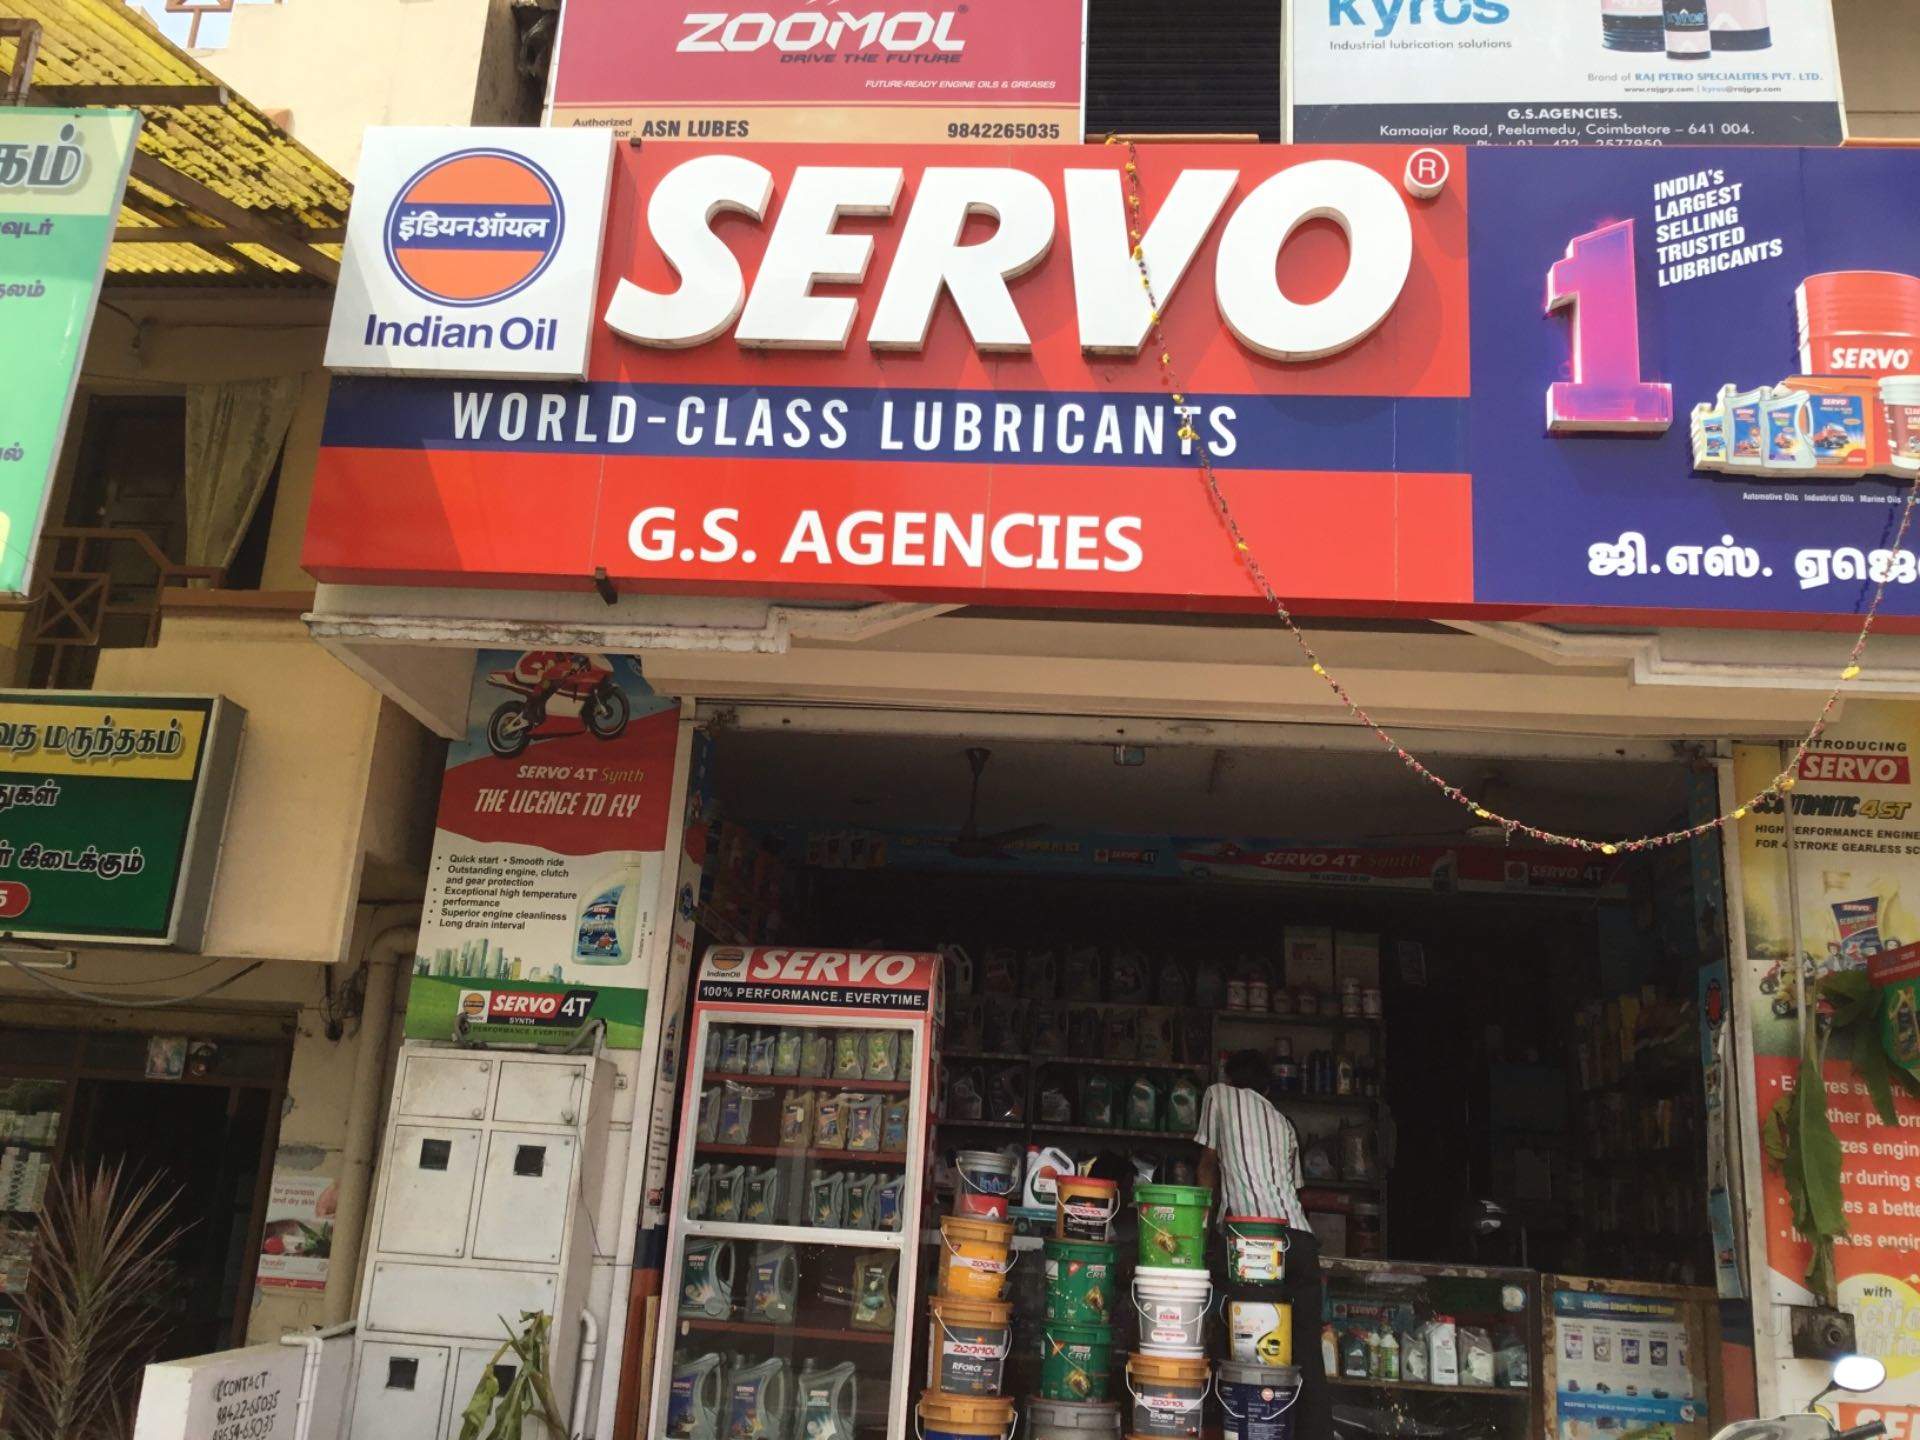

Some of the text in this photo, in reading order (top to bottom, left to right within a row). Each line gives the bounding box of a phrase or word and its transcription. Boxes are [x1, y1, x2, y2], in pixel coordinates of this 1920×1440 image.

[675, 11, 966, 52] ZOOMOL
[1329, 39, 1512, 50] Industrial lubrication solutions
[780, 53, 963, 64] DRIVE THE FUTURE
[865, 80, 937, 89] FUTURE-READY
[939, 80, 976, 89] ENGINE
[978, 81, 1000, 89] OILS
[1010, 81, 1056, 89] GREASES
[1587, 73, 1823, 82] Brand of RAJ PETRO SPECIALITIES PVT. LTD.
[1508, 108, 1622, 120] G.S.AGENCIES.
[572, 118, 633, 128] Authorized
[641, 120, 681, 137] ASN
[688, 120, 750, 138] LUBES
[947, 122, 1060, 140] 9842265035
[1380, 123, 1755, 139] Kamaajar Road, Peelamedu, Coimbatore 641 004.
[1654, 169, 1725, 201] INDIA's
[1655, 183, 1743, 222] LARGEST
[1656, 206, 1739, 243] SELLING
[1657, 226, 1746, 265] TRUSTED
[604, 154, 1413, 362] SERVO
[1658, 238, 1783, 288] LUBRICANTS
[1830, 347, 1911, 371] SERVO
[452, 391, 1238, 458] WORLD-CLASS LUBRICANTS
[1743, 492, 1799, 501] Automotive Oils
[1804, 493, 1839, 502] Industrial
[1860, 494, 1885, 503] Marine
[627, 505, 1144, 572] G.S. AGENCIES
[44, 714, 183, 758] மருந்தகம்
[517, 765, 645, 784] SERVO 4T Synth
[1803, 754, 1898, 782] SERVO
[474, 788, 642, 818] THE LICENCE TO FLY
[1755, 825, 1785, 834] HIGH
[1793, 826, 1874, 839] ERFORMANCE
[1755, 839, 1778, 849] FOR
[1842, 843, 1902, 855] GEARLESS
[450, 855, 565, 867] Quick start Smooth ride
[448, 865, 569, 878] Outstanding engine, clutch
[446, 876, 534, 888] and gear protection
[444, 887, 577, 900] Exceptional high temperature
[443, 898, 500, 908] performance
[441, 908, 567, 921] Superior engine cleanliness
[439, 919, 526, 930] Long drain interval
[752, 949, 916, 986] SERVO
[703, 985, 926, 1007] 100% PERFORMANCE. EVERYTIME.
[492, 994, 592, 1017] SERVO 4T
[509, 1017, 535, 1025] SYNTH
[1856, 1170, 1911, 1191] during
[1868, 1203, 1879, 1214] a
[1863, 1287, 1893, 1298] with
